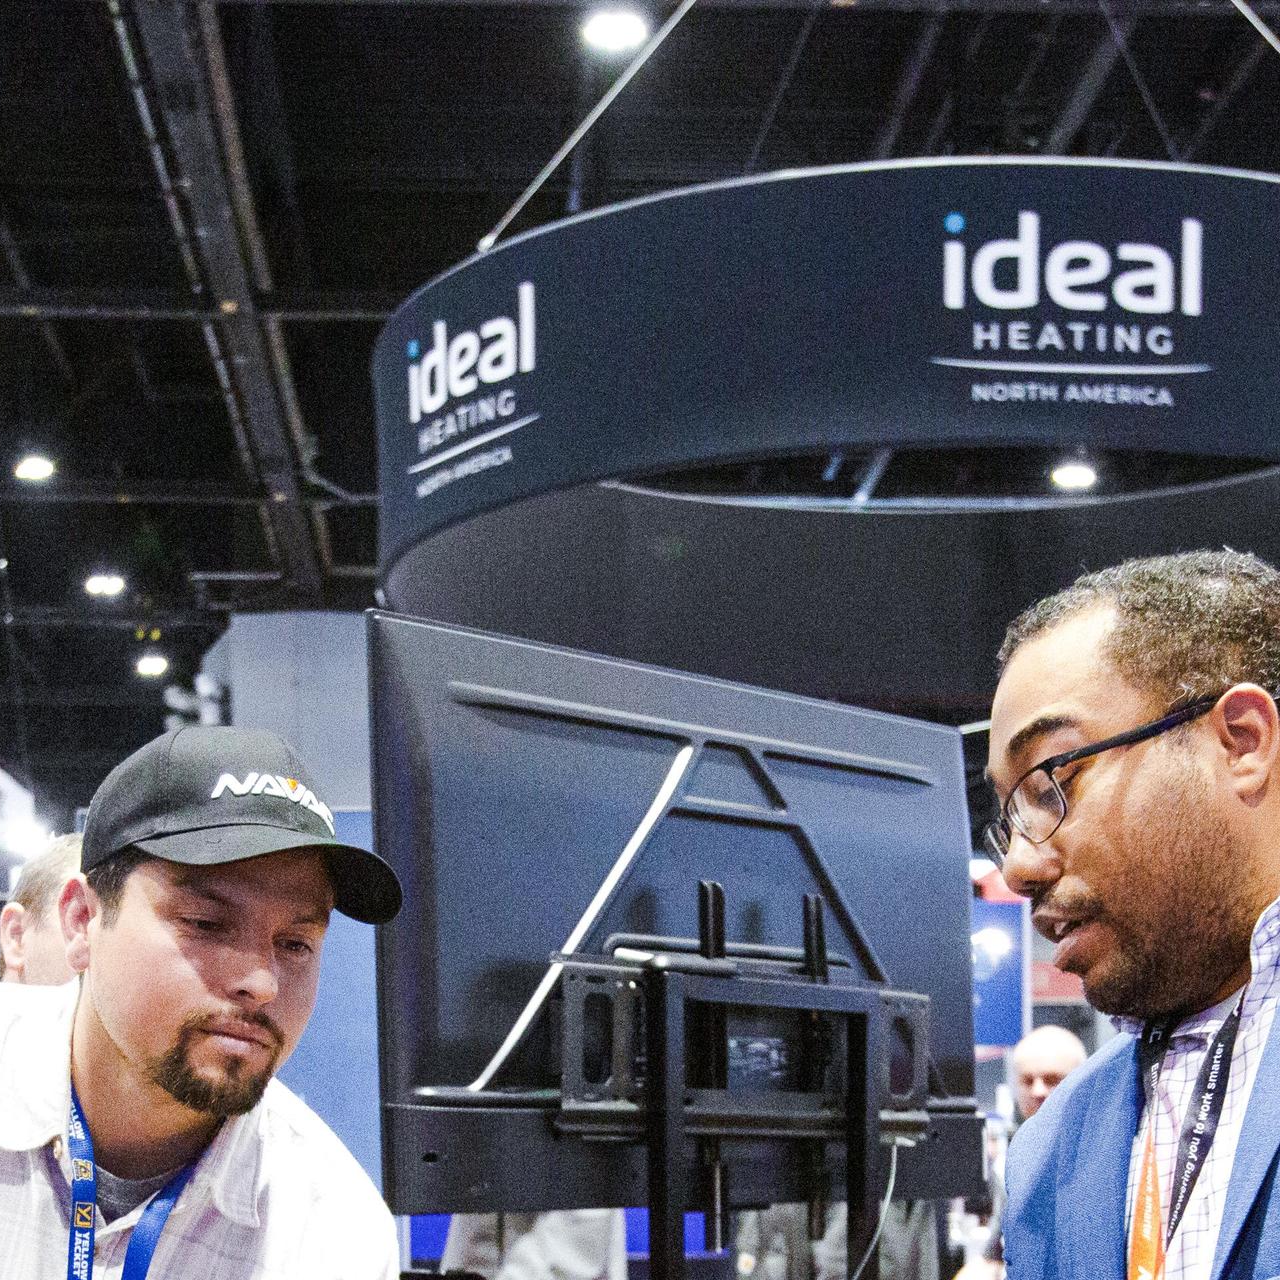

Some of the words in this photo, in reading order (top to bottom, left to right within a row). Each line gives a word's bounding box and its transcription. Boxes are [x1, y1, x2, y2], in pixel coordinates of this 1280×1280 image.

[942, 209, 1204, 317] ideal
[407, 280, 536, 424] ideal
[972, 320, 1175, 356] HEATING
[970, 381, 1059, 402] NORTH
[1064, 383, 1175, 407] AMERICA
[418, 388, 517, 454] HEATING
[1207, 1042, 1226, 1090] smarter
[1197, 1092, 1214, 1122] work
[1186, 1137, 1201, 1161] you
[1192, 1122, 1205, 1136] to
[73, 1229, 82, 1279] JACKET
